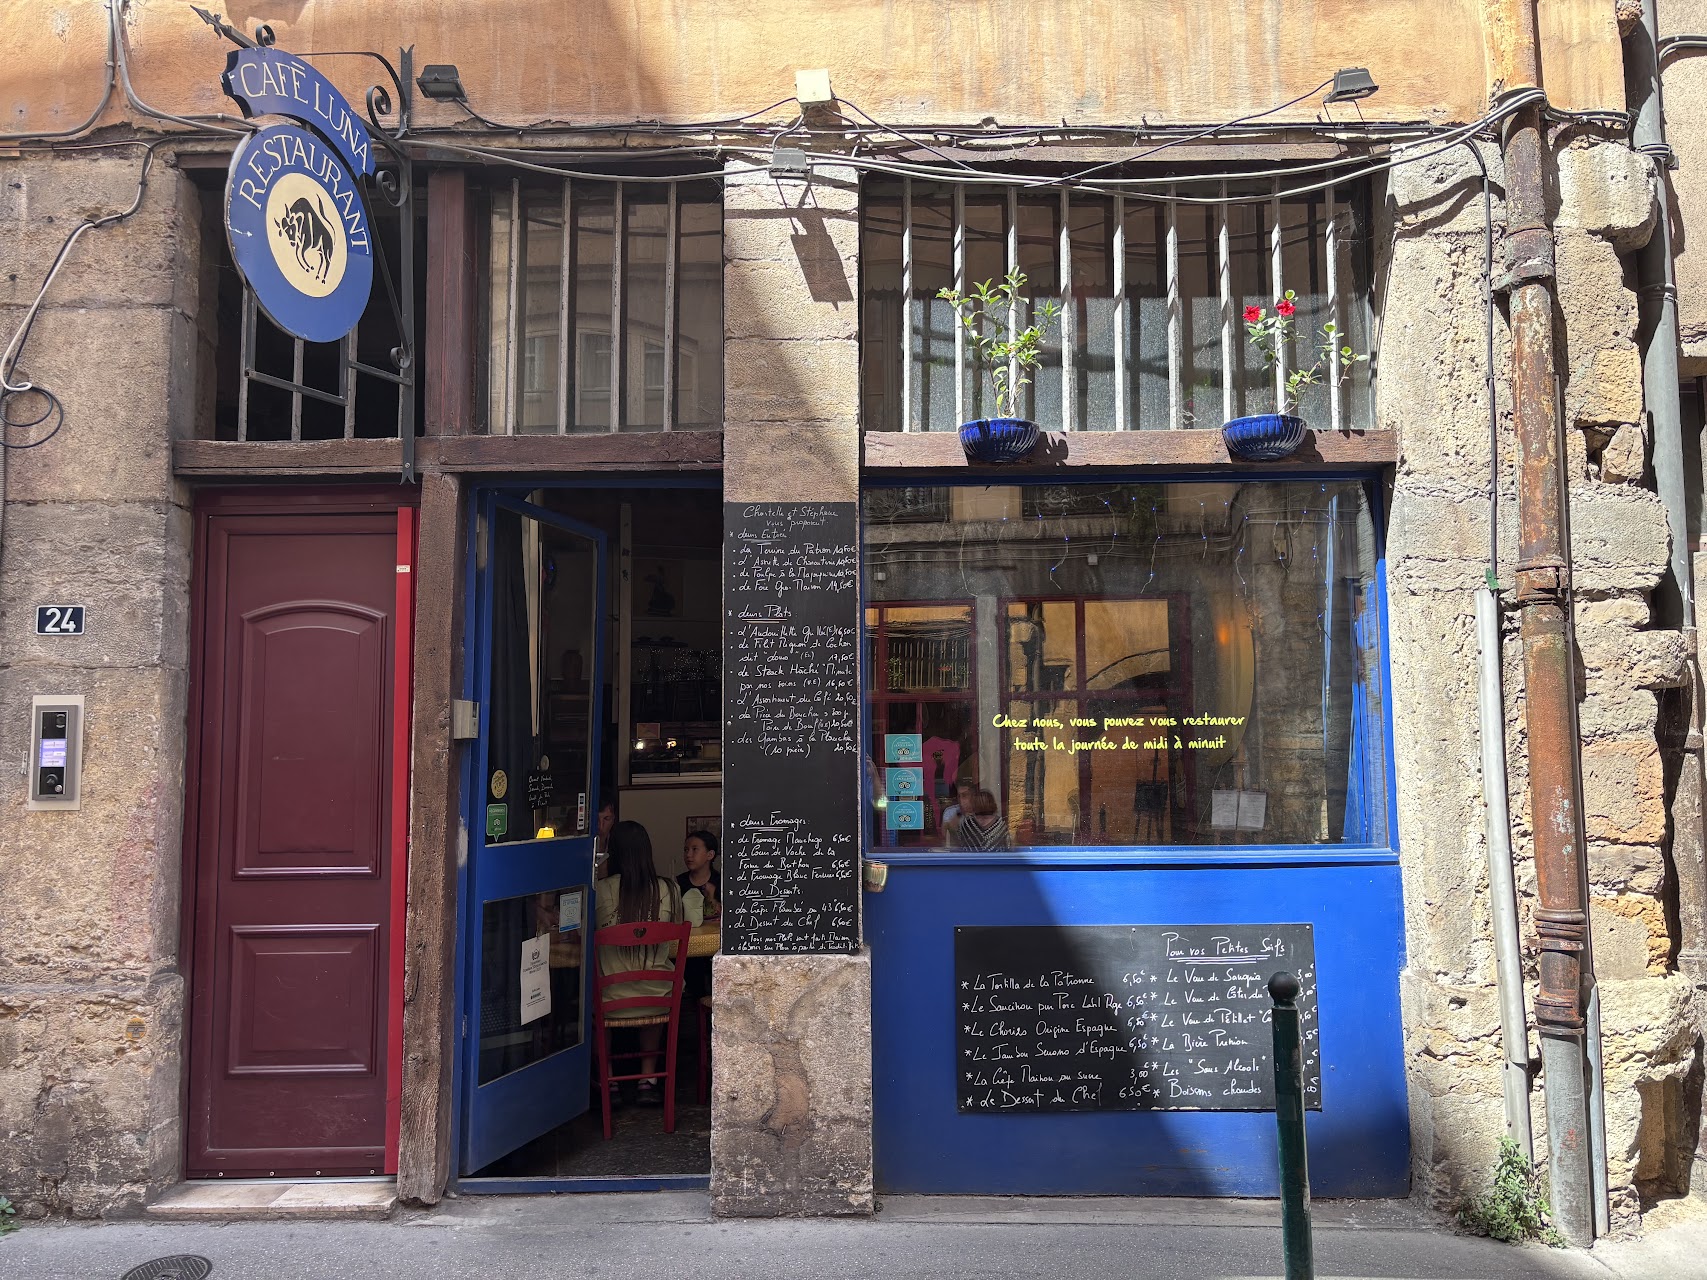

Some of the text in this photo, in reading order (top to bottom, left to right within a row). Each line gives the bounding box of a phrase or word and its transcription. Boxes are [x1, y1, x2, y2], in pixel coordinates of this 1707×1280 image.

[314, 80, 368, 173] LUNA
[239, 135, 370, 255] RESTAURANT
[45, 607, 76, 633] 24
[992, 712, 1246, 731] Chez nous, vous pouvez vous restaurer
[1014, 735, 1227, 755] toute la journée de midi à minuit
[1190, 948, 1205, 956] vos
[1210, 936, 1249, 955] Petites
